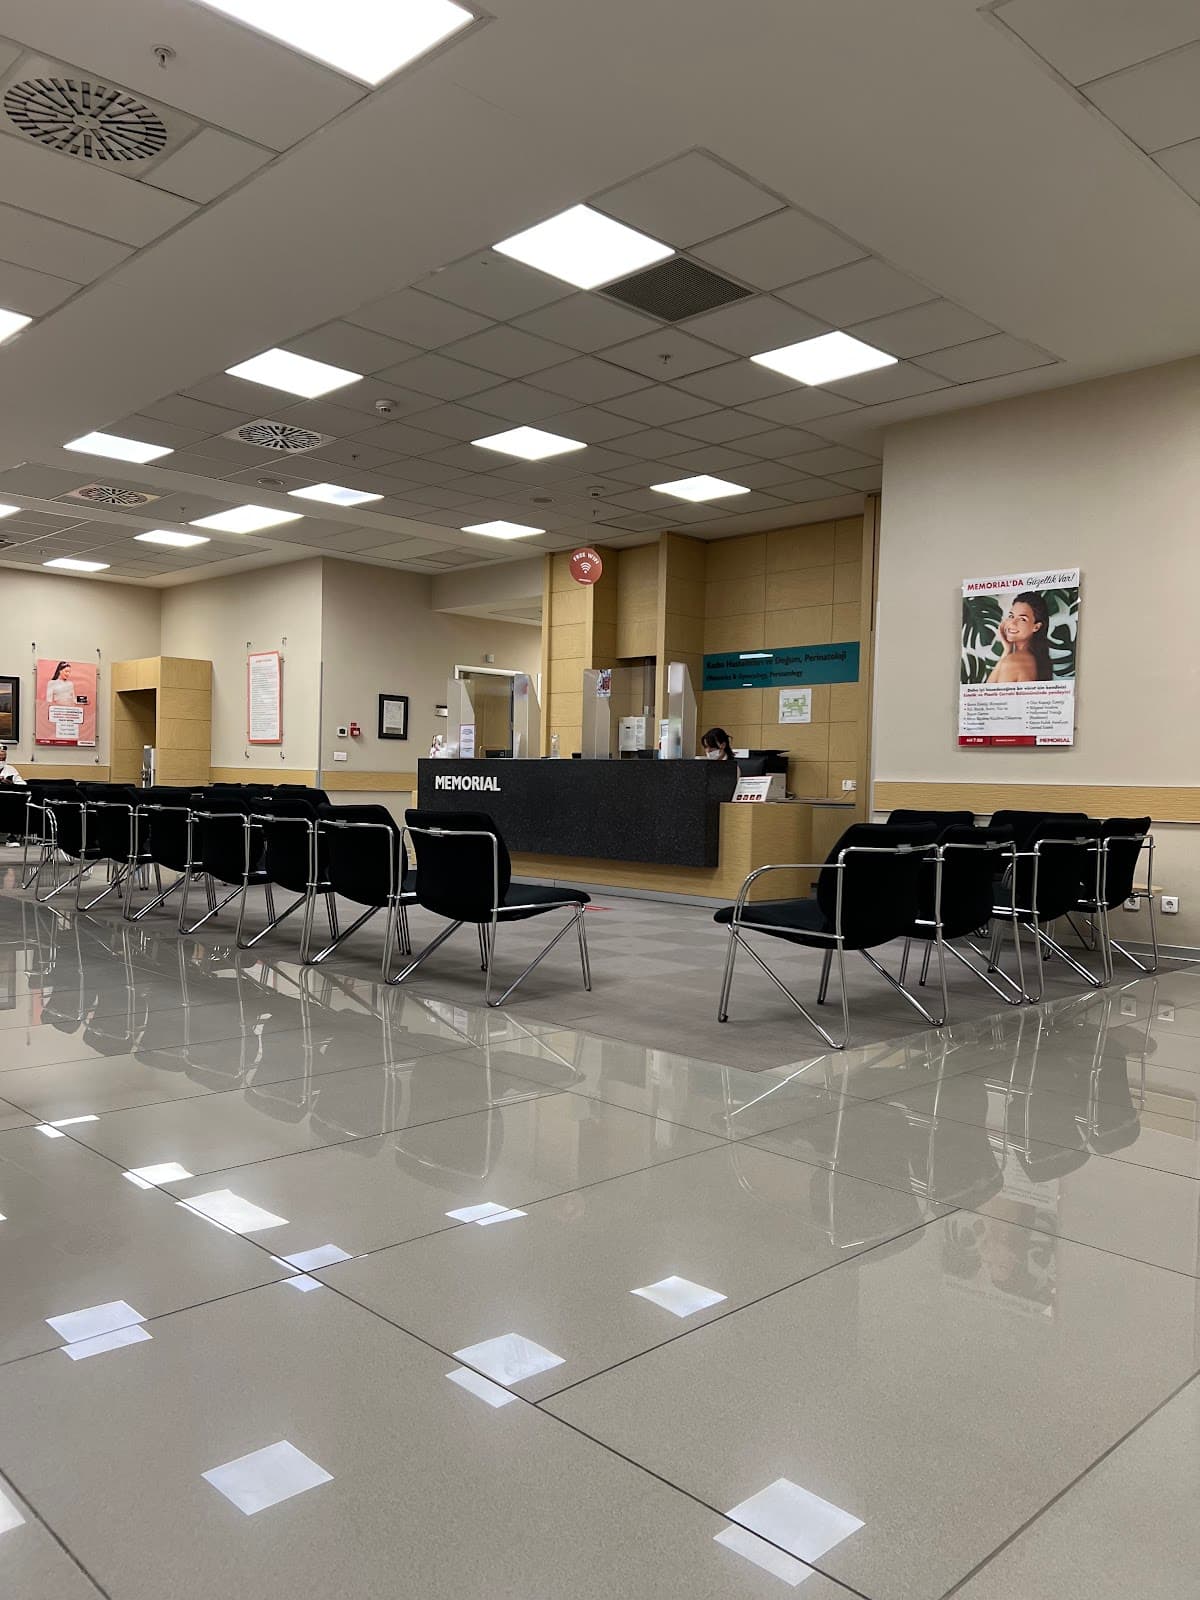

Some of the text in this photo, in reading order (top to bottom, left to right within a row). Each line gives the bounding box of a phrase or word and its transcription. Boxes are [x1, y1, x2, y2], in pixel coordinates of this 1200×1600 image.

[573, 552, 600, 565] FREE WIFI
[967, 572, 1076, 591] MEMORIAL'DA Güzellik Var!
[435, 775, 502, 791] MEMORIAL
